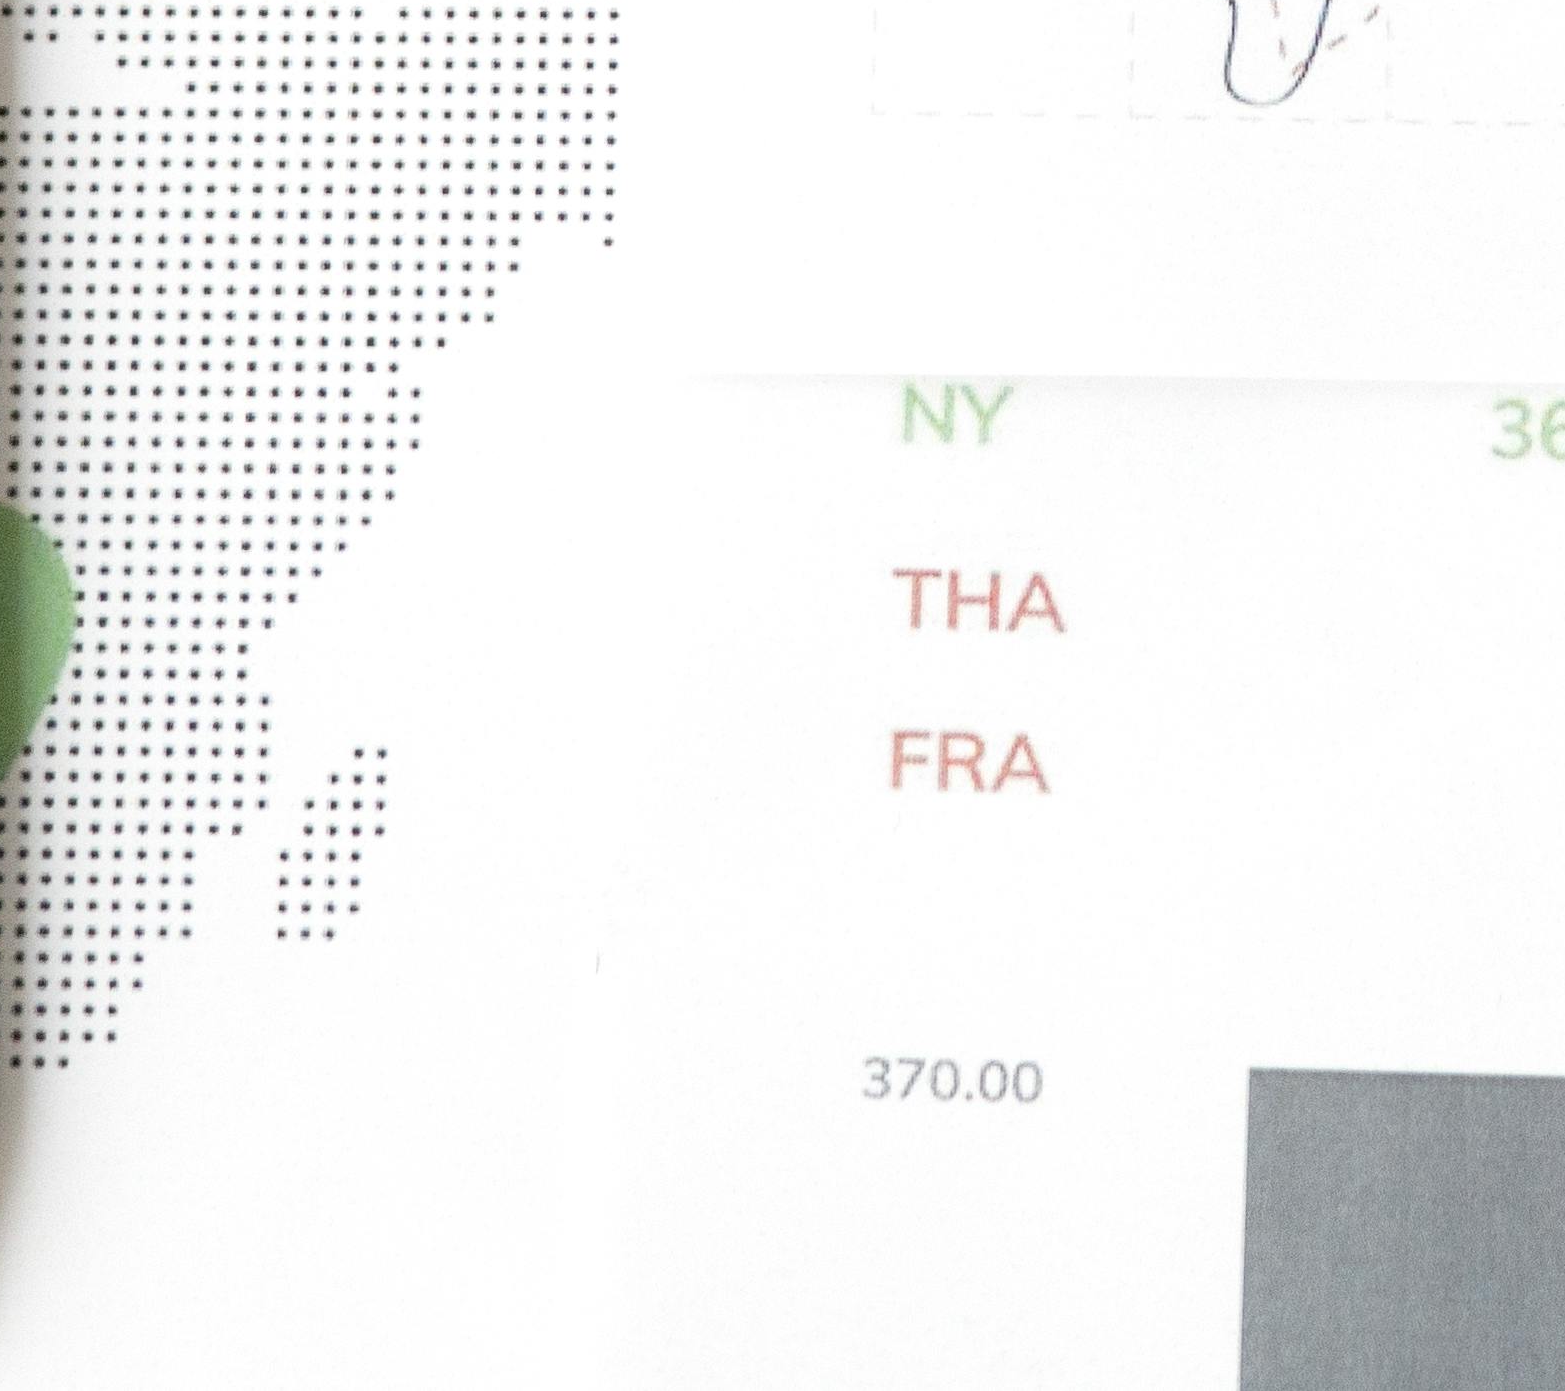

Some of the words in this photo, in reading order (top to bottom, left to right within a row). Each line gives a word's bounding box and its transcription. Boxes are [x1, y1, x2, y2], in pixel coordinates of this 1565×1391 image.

[904, 385, 1012, 442] NY
[893, 569, 1065, 633] THA
[892, 730, 1048, 792] FRA
[864, 1056, 1043, 1103] 370.00
